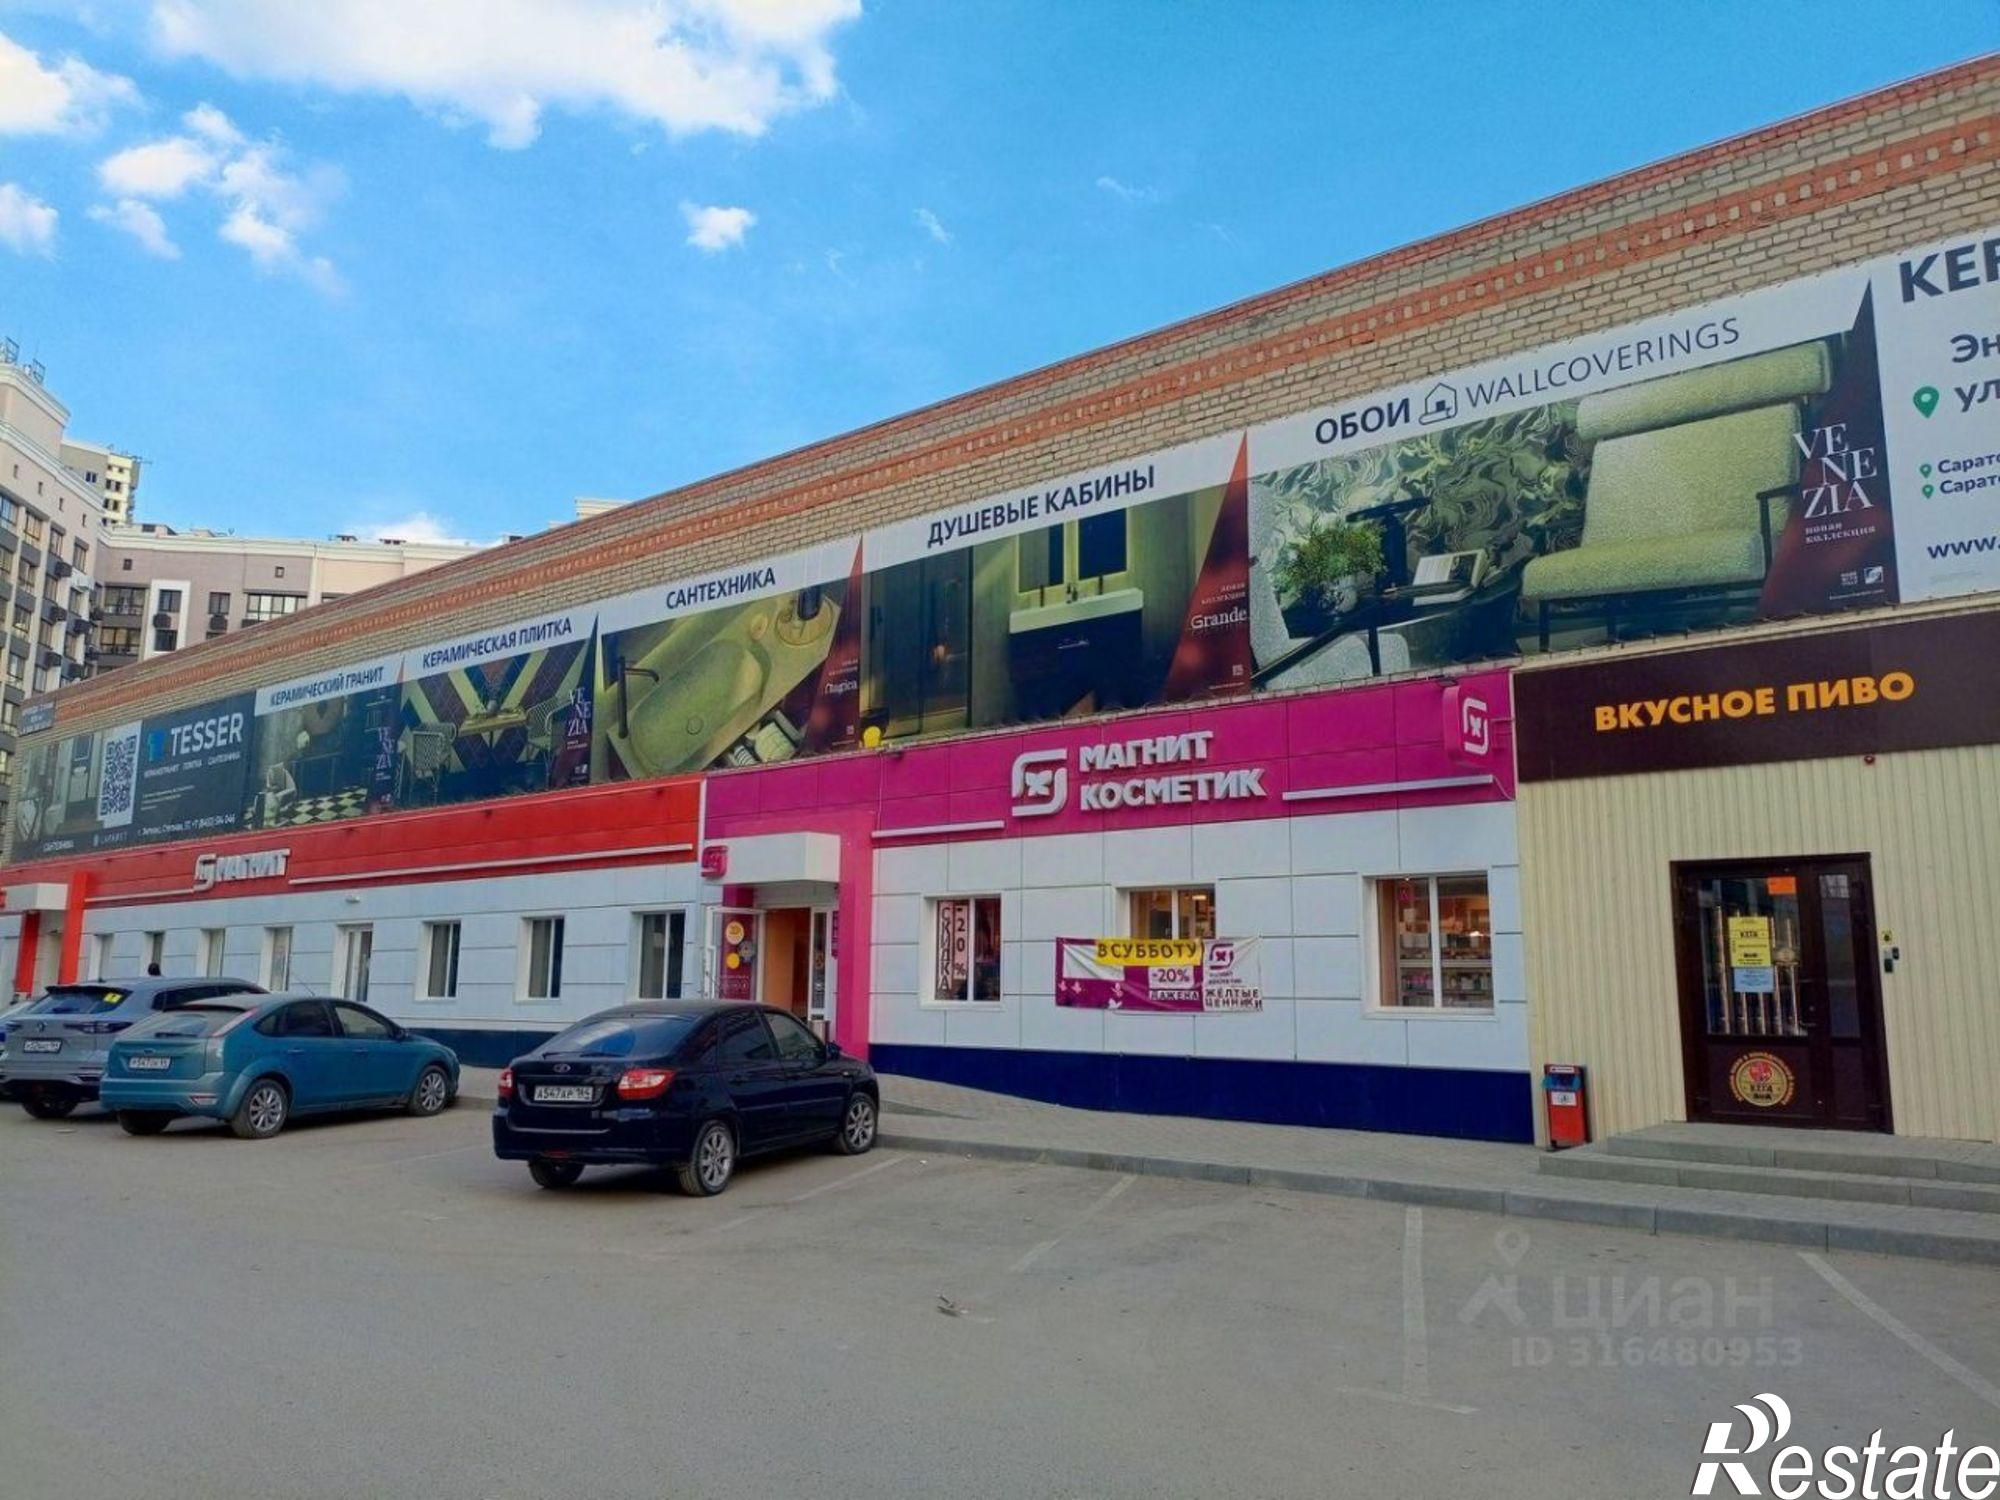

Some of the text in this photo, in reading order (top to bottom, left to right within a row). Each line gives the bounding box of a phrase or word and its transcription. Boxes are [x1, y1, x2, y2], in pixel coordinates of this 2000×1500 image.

[1465, 318, 1740, 408] WALLCOVERINGS
[1315, 398, 1411, 445] ОБОИ
[1793, 423, 1849, 460] VE
[1821, 447, 1878, 486] NE
[1939, 473, 2000, 495] Сарат
[928, 465, 1155, 548] ДУШЕВЫЕ КАБИНЫ
[1802, 480, 1874, 519] ZIA
[666, 567, 776, 609] САНТЕХНИКА
[1191, 606, 1247, 629] Grande
[422, 616, 572, 669] КЕРАМИЧЕСКАЯ ПЛИТКА
[269, 666, 385, 706] КЕРАМИЧЕСКИЙ ГРАНИТ
[1595, 671, 1915, 732] ВКУСНОЕ ПИВО
[171, 711, 243, 757] TESSER
[1079, 730, 1214, 772] МАГНИТ
[1080, 768, 1267, 812] КОСМЕТИК
[214, 848, 290, 882] МАГНИТ
[953, 906, 966, 976] -20%
[1152, 968, 1190, 983] -20%
